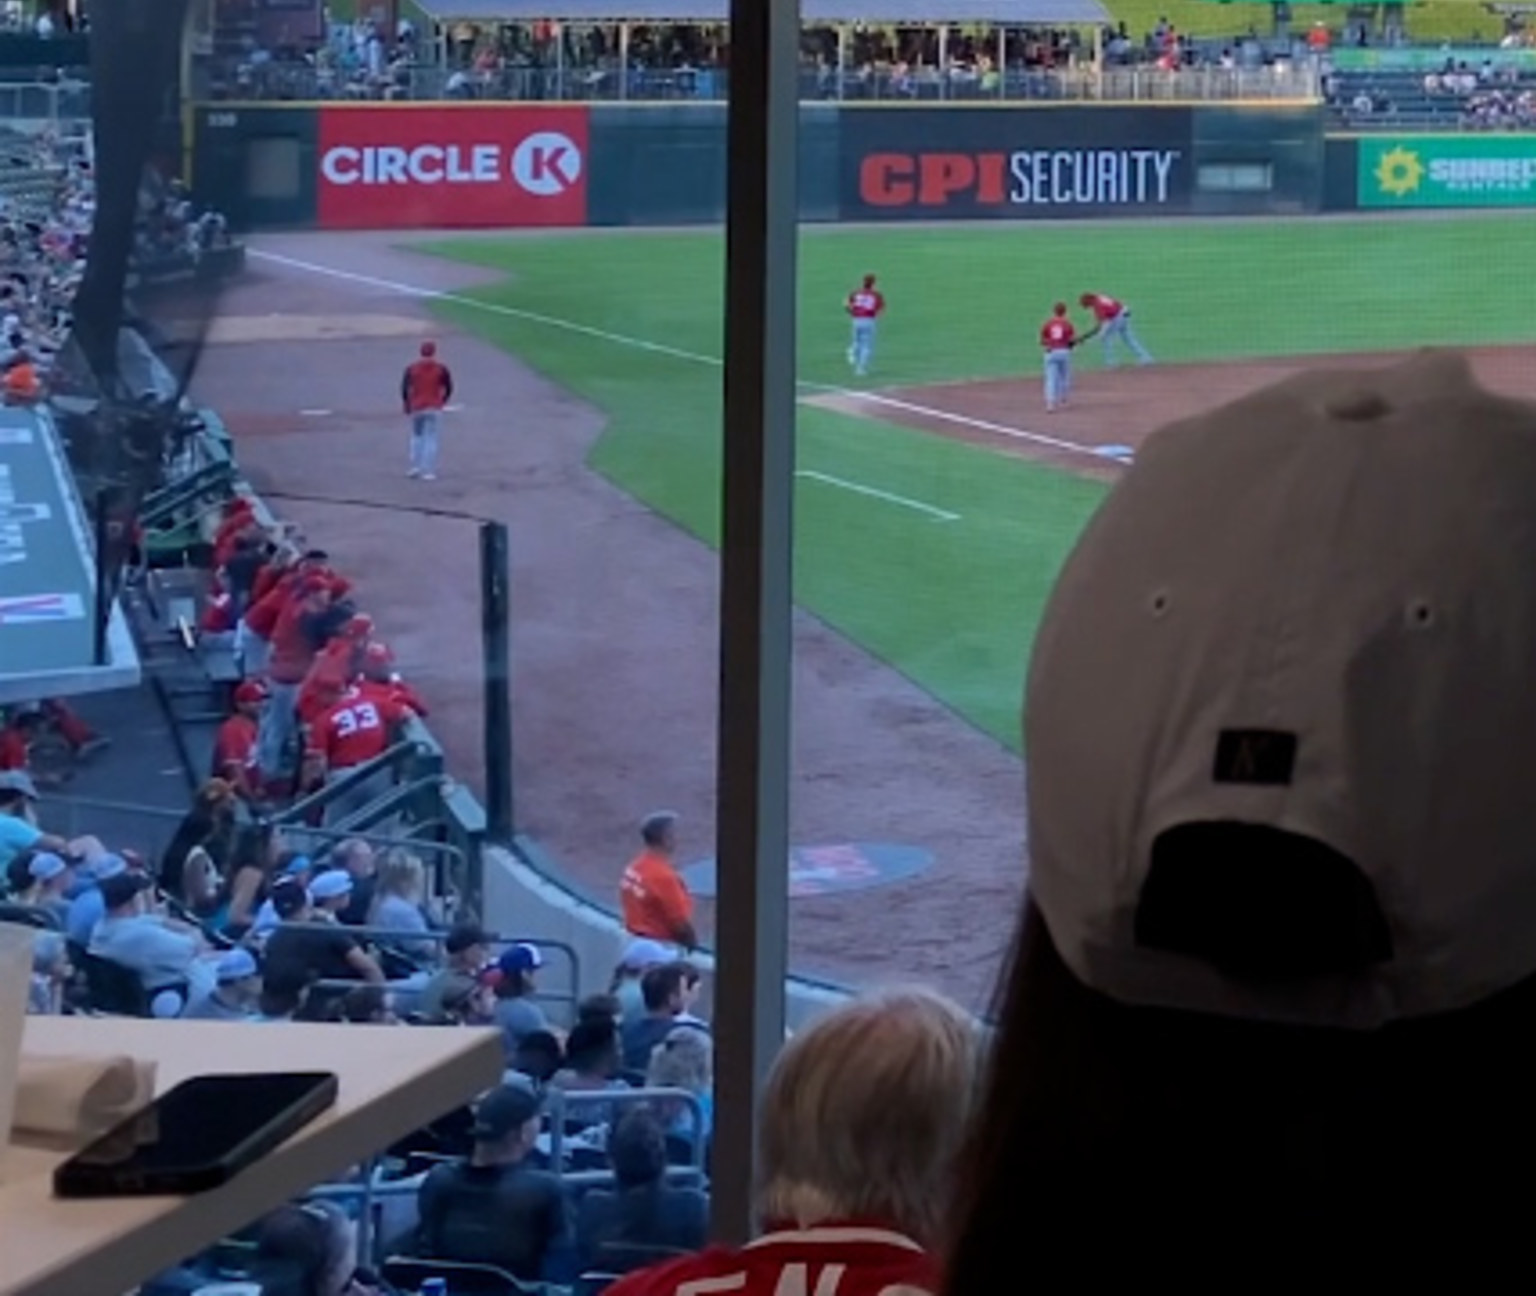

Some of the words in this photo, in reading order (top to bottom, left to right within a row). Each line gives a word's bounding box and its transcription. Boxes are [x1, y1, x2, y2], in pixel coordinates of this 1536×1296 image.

[321, 144, 501, 184] CIRCLE
[529, 145, 573, 189] K
[859, 151, 1006, 205] CPI
[1010, 150, 1174, 204] SECURITY
[330, 701, 380, 738] 33
